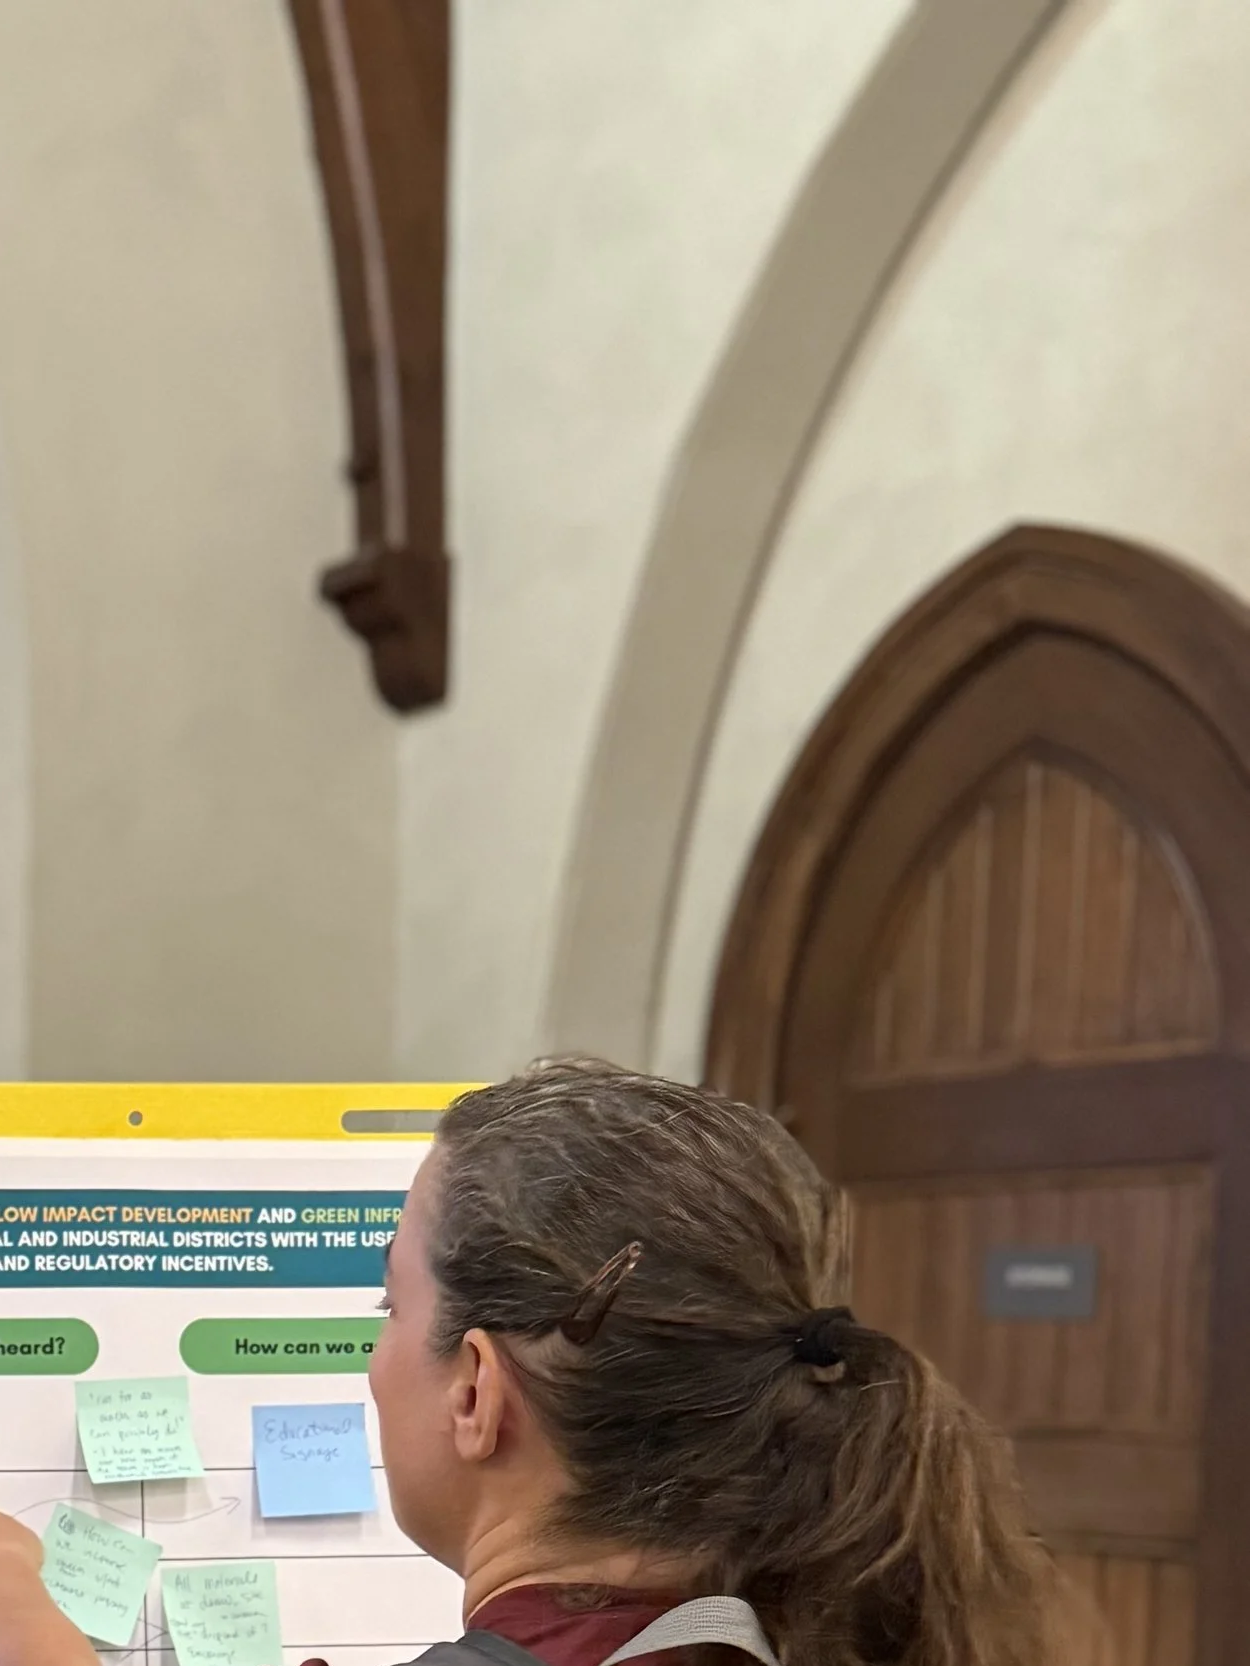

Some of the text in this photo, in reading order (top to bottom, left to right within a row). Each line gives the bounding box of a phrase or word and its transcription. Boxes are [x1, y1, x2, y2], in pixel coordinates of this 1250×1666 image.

[42, 1206, 118, 1224] IMPACT
[121, 1207, 254, 1224] DEVELOPMENT
[257, 1207, 297, 1224] AND
[301, 1208, 360, 1224] GREEN
[18, 1231, 58, 1247] AND
[62, 1231, 169, 1248] INDUSTRIAL
[173, 1231, 267, 1248] DISTRICTS
[270, 1231, 318, 1248] WITH
[322, 1231, 357, 1247] THE
[34, 1255, 157, 1272] REGULATORY
[161, 1255, 274, 1272] INCENTIVES.
[235, 1338, 278, 1355] How
[283, 1342, 320, 1355] can
[325, 1342, 355, 1354] we
